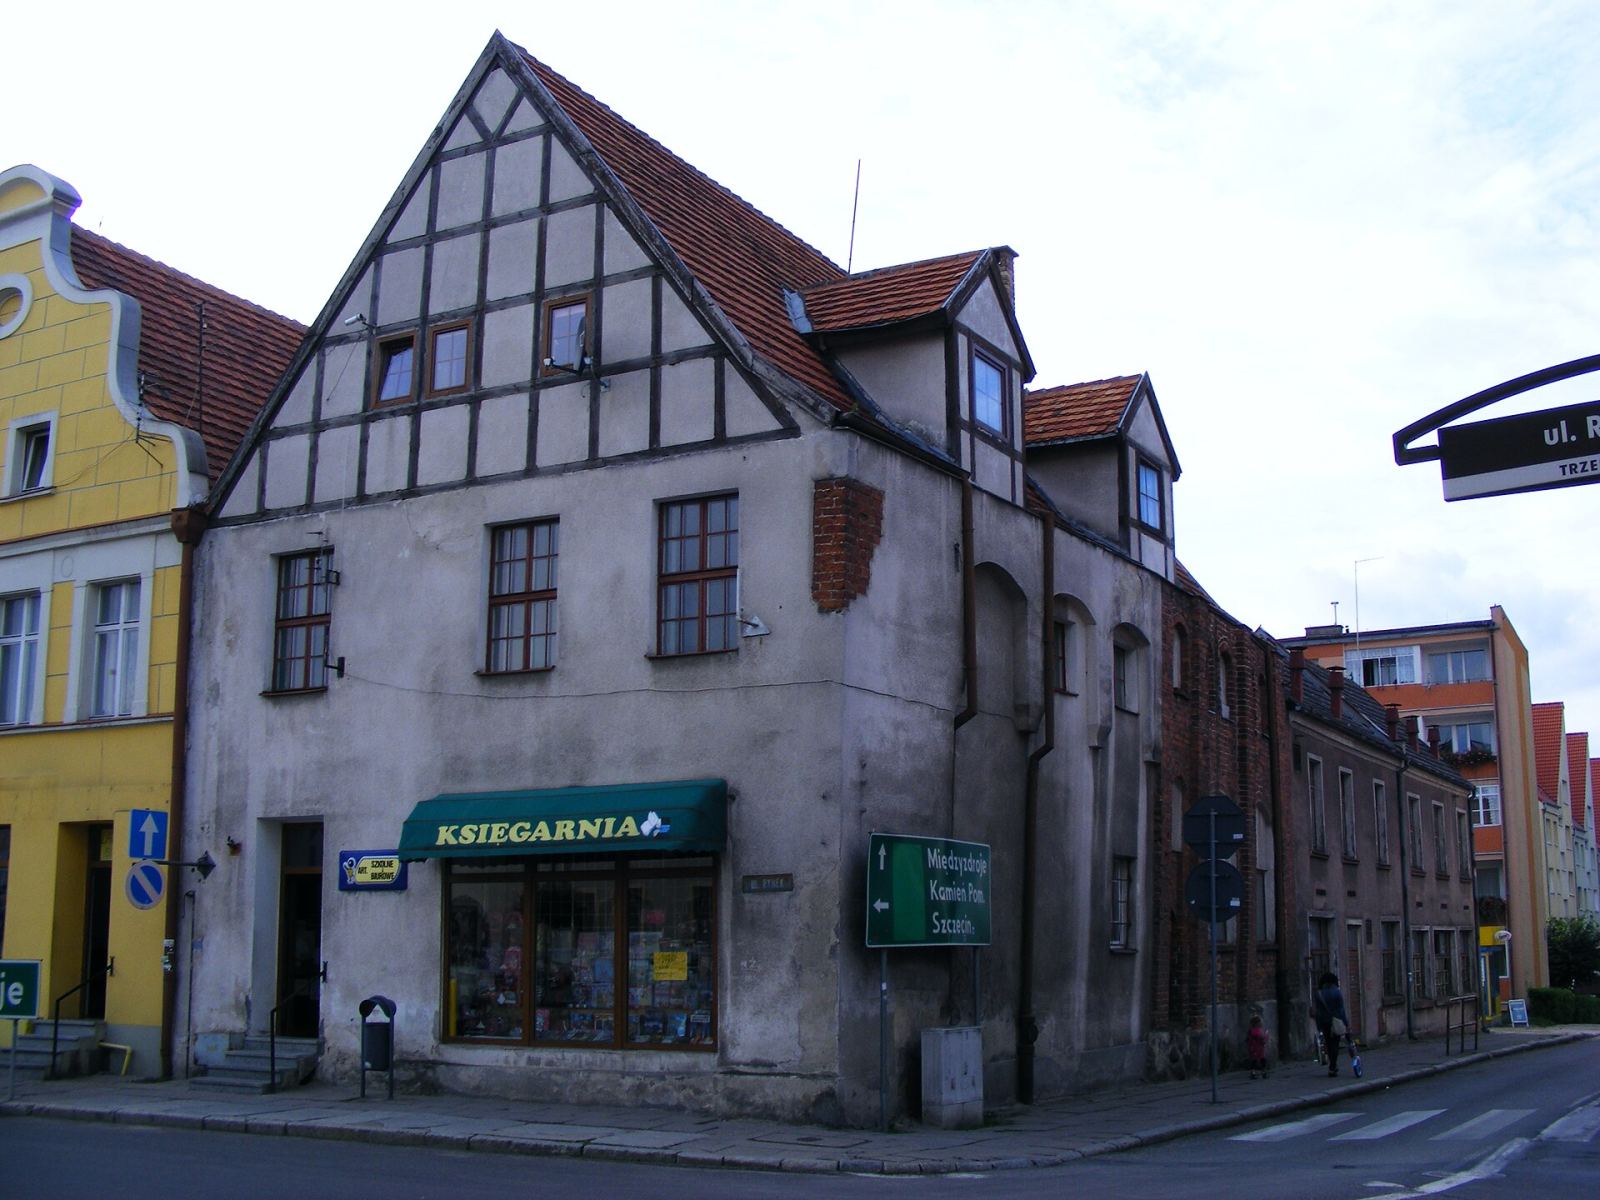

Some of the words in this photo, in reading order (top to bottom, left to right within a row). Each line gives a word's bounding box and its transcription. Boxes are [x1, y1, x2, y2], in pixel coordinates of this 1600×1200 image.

[1543, 420, 1577, 446] ul.
[435, 815, 640, 847] KSIĘGARNIA
[371, 860, 394, 868] SZKOLNE
[927, 847, 987, 878] Międzyzdroje
[371, 872, 395, 881] BIUROWE
[929, 879, 966, 903] Kamień
[968, 882, 985, 905] Pom.
[932, 911, 972, 935] Szczecin
